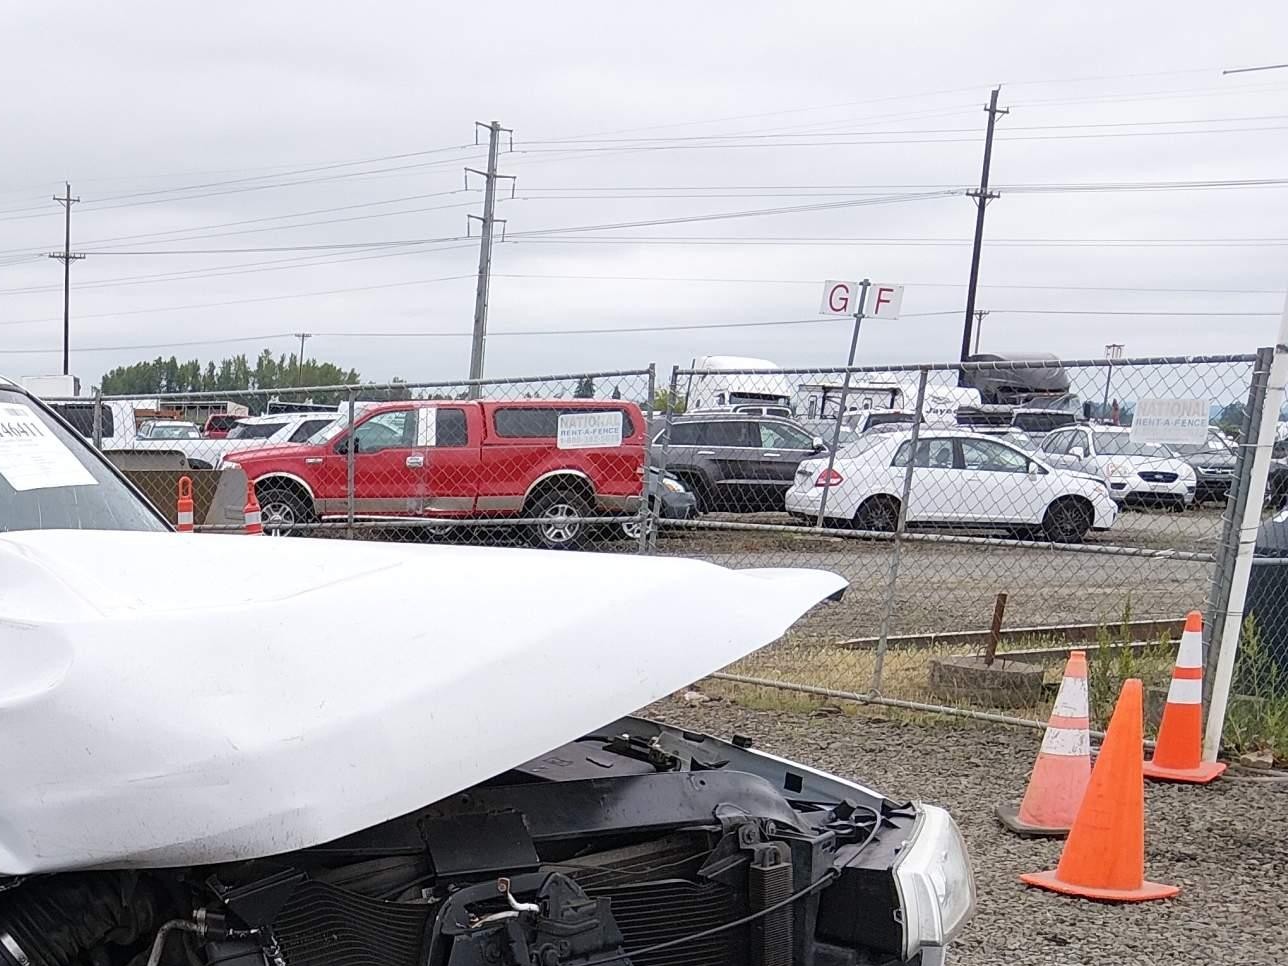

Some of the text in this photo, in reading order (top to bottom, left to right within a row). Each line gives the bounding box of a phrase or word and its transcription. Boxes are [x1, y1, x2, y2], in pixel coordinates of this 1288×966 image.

[829, 284, 849, 312] G
[875, 288, 894, 315] F
[1138, 400, 1207, 416] NATIONAL
[560, 413, 620, 429] NATIONAL
[1135, 417, 1207, 428] RENT-A-FENCE
[560, 427, 619, 437] RENT-A-FENCE
